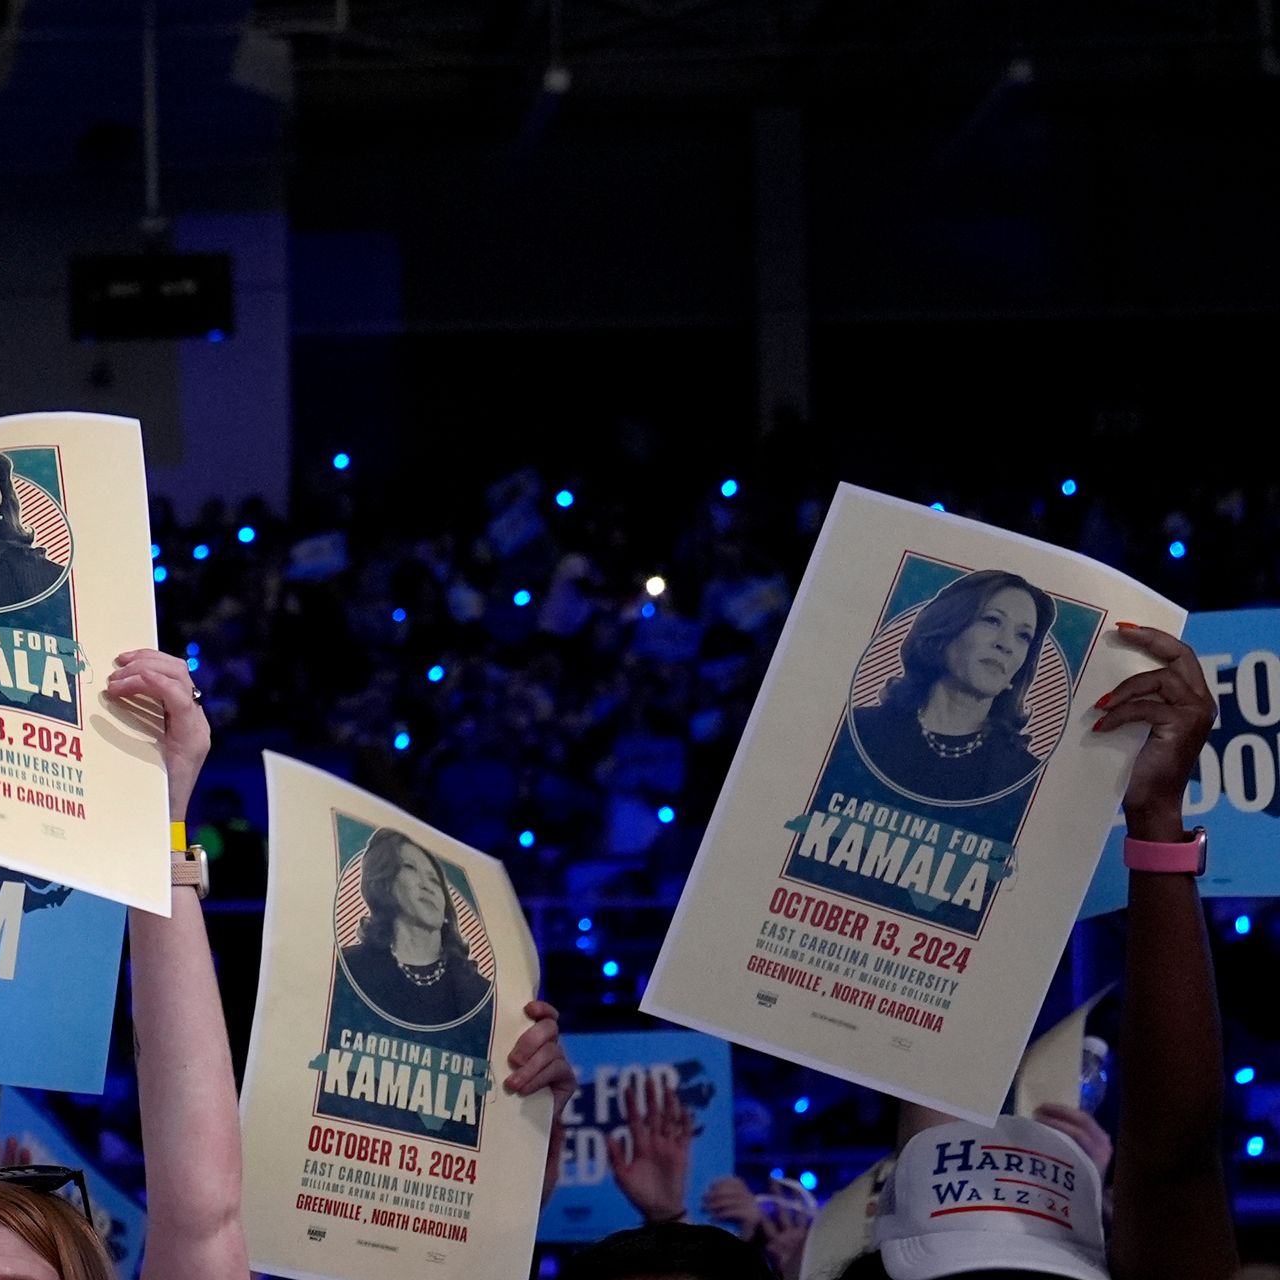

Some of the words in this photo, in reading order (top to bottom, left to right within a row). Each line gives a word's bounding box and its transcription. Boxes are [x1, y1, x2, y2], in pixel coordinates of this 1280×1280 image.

[13, 630, 58, 654] FOR
[22, 722, 83, 762] 2024
[16, 786, 86, 820] CAROLINA
[828, 792, 940, 844] CAROLINA
[948, 830, 993, 859] FOR
[798, 810, 990, 912] KAMALA
[769, 887, 869, 941] OCTOBER
[872, 920, 901, 957] 13,
[907, 932, 972, 974] 2024
[760, 920, 795, 943] EAST
[799, 933, 869, 969] CAROLINA
[873, 956, 959, 997] UNIVERSITY
[830, 982, 877, 1010] NORTH
[877, 998, 945, 1033] CAROLINA
[341, 1029, 431, 1068] CAROLINA
[440, 1052, 474, 1076] FOR
[324, 1048, 476, 1126] KAMALA
[308, 1125, 392, 1167] OCTOBER
[398, 1144, 422, 1176] 13,
[429, 1151, 477, 1184] 2024
[932, 1139, 1076, 1192] HARRIS
[304, 1159, 334, 1177] EAST
[339, 1166, 398, 1192] CAROLINA
[403, 1179, 474, 1207] UNIVERSITY
[932, 1180, 1030, 1205] WALZ
[371, 1208, 409, 1232] NORTH
[412, 1217, 468, 1243] CAROLINA
